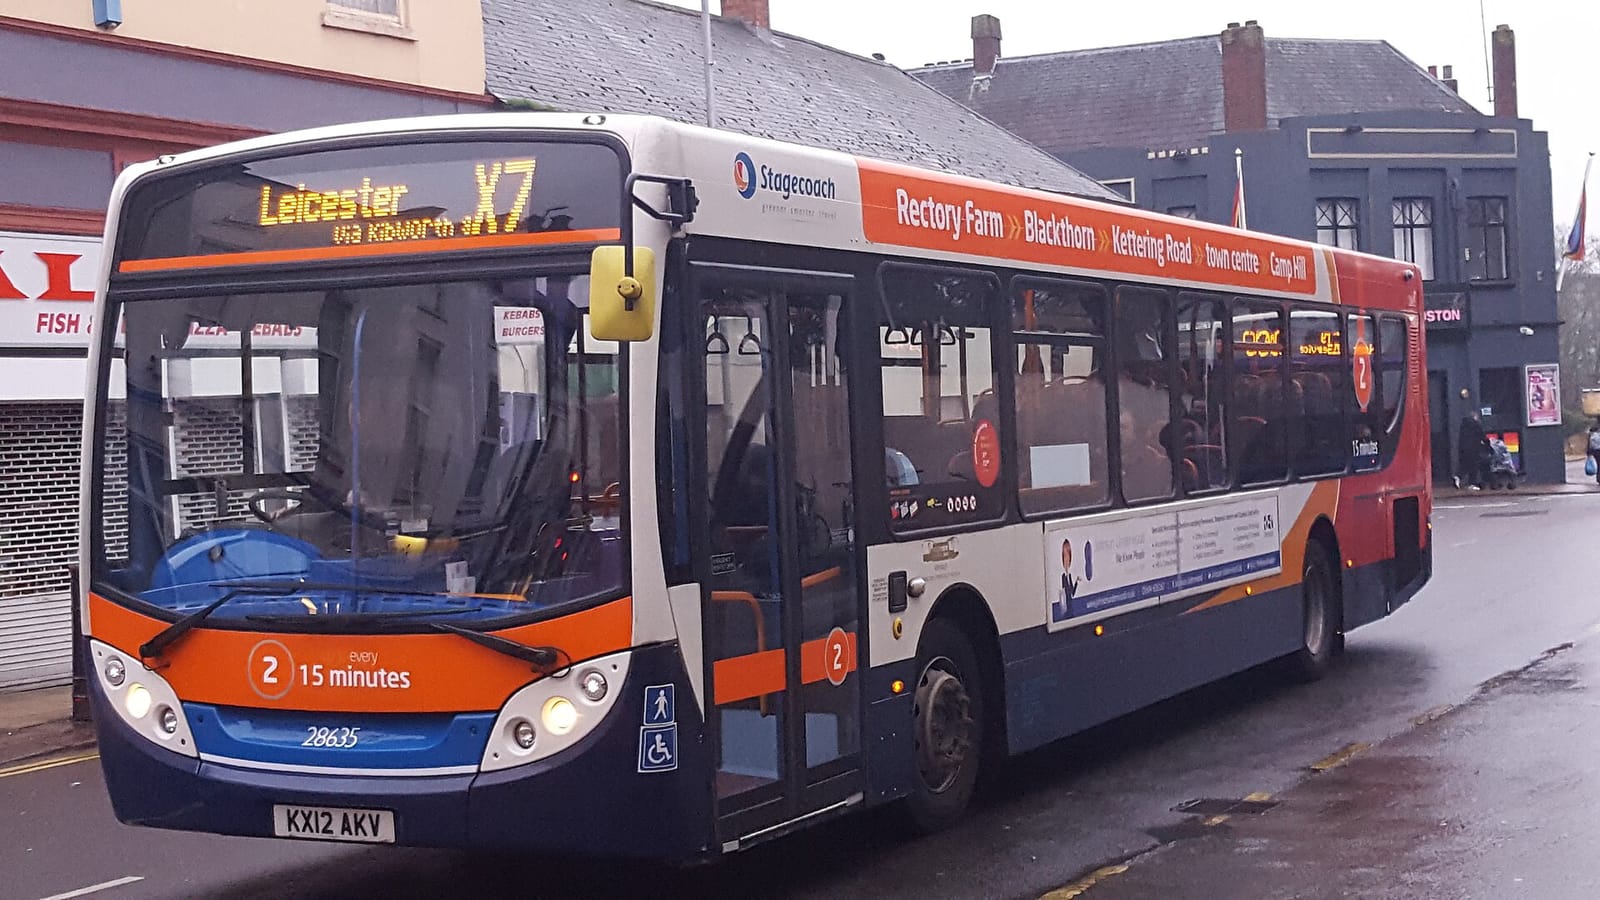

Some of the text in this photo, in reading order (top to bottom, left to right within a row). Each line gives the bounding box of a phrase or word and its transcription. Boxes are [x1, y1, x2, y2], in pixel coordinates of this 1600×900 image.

[761, 164, 836, 200] Stagecoach
[259, 176, 408, 226] Leicester
[475, 159, 536, 234] X7
[367, 216, 455, 242] Kibworth
[896, 188, 1307, 283] Rectory Farm Blackthorn Kettering Road town centre Camp Hill
[37, 313, 80, 334] FISH
[503, 310, 541, 320] KEBABS
[1424, 310, 1460, 321] STON
[502, 326, 544, 337] BURGERS
[1359, 357, 1367, 389] 2
[1352, 439, 1359, 456] 15
[350, 650, 378, 665] every
[833, 643, 842, 670] 2
[262, 656, 278, 684] 2
[299, 664, 410, 689] 15 minutes
[302, 726, 361, 748] 28635
[286, 809, 381, 837] KX12 AKV
